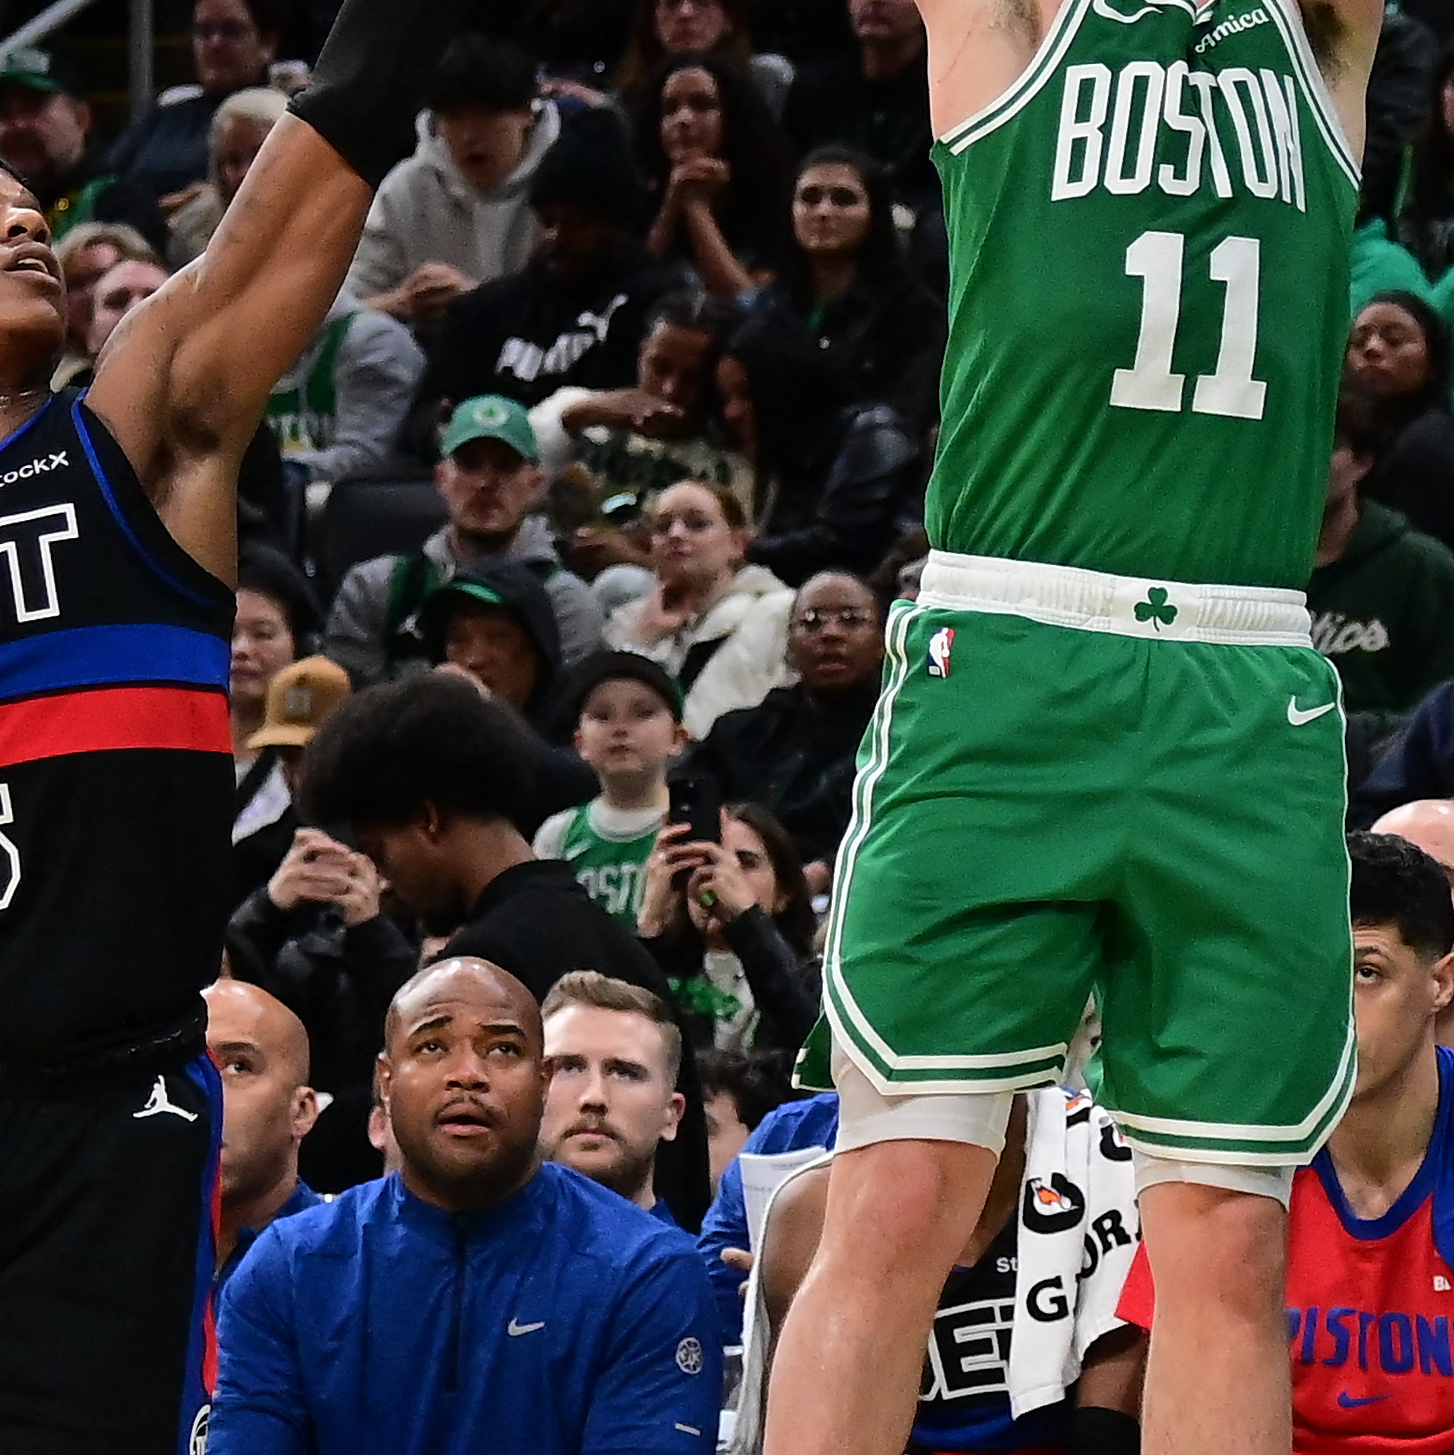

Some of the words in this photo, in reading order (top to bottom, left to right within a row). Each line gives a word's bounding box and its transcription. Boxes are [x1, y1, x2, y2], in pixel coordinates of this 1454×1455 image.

[1194, 7, 1270, 54] Amica
[1051, 60, 1306, 213] BOSTON
[1109, 230, 1268, 420] 11
[1310, 610, 1391, 655] tics
